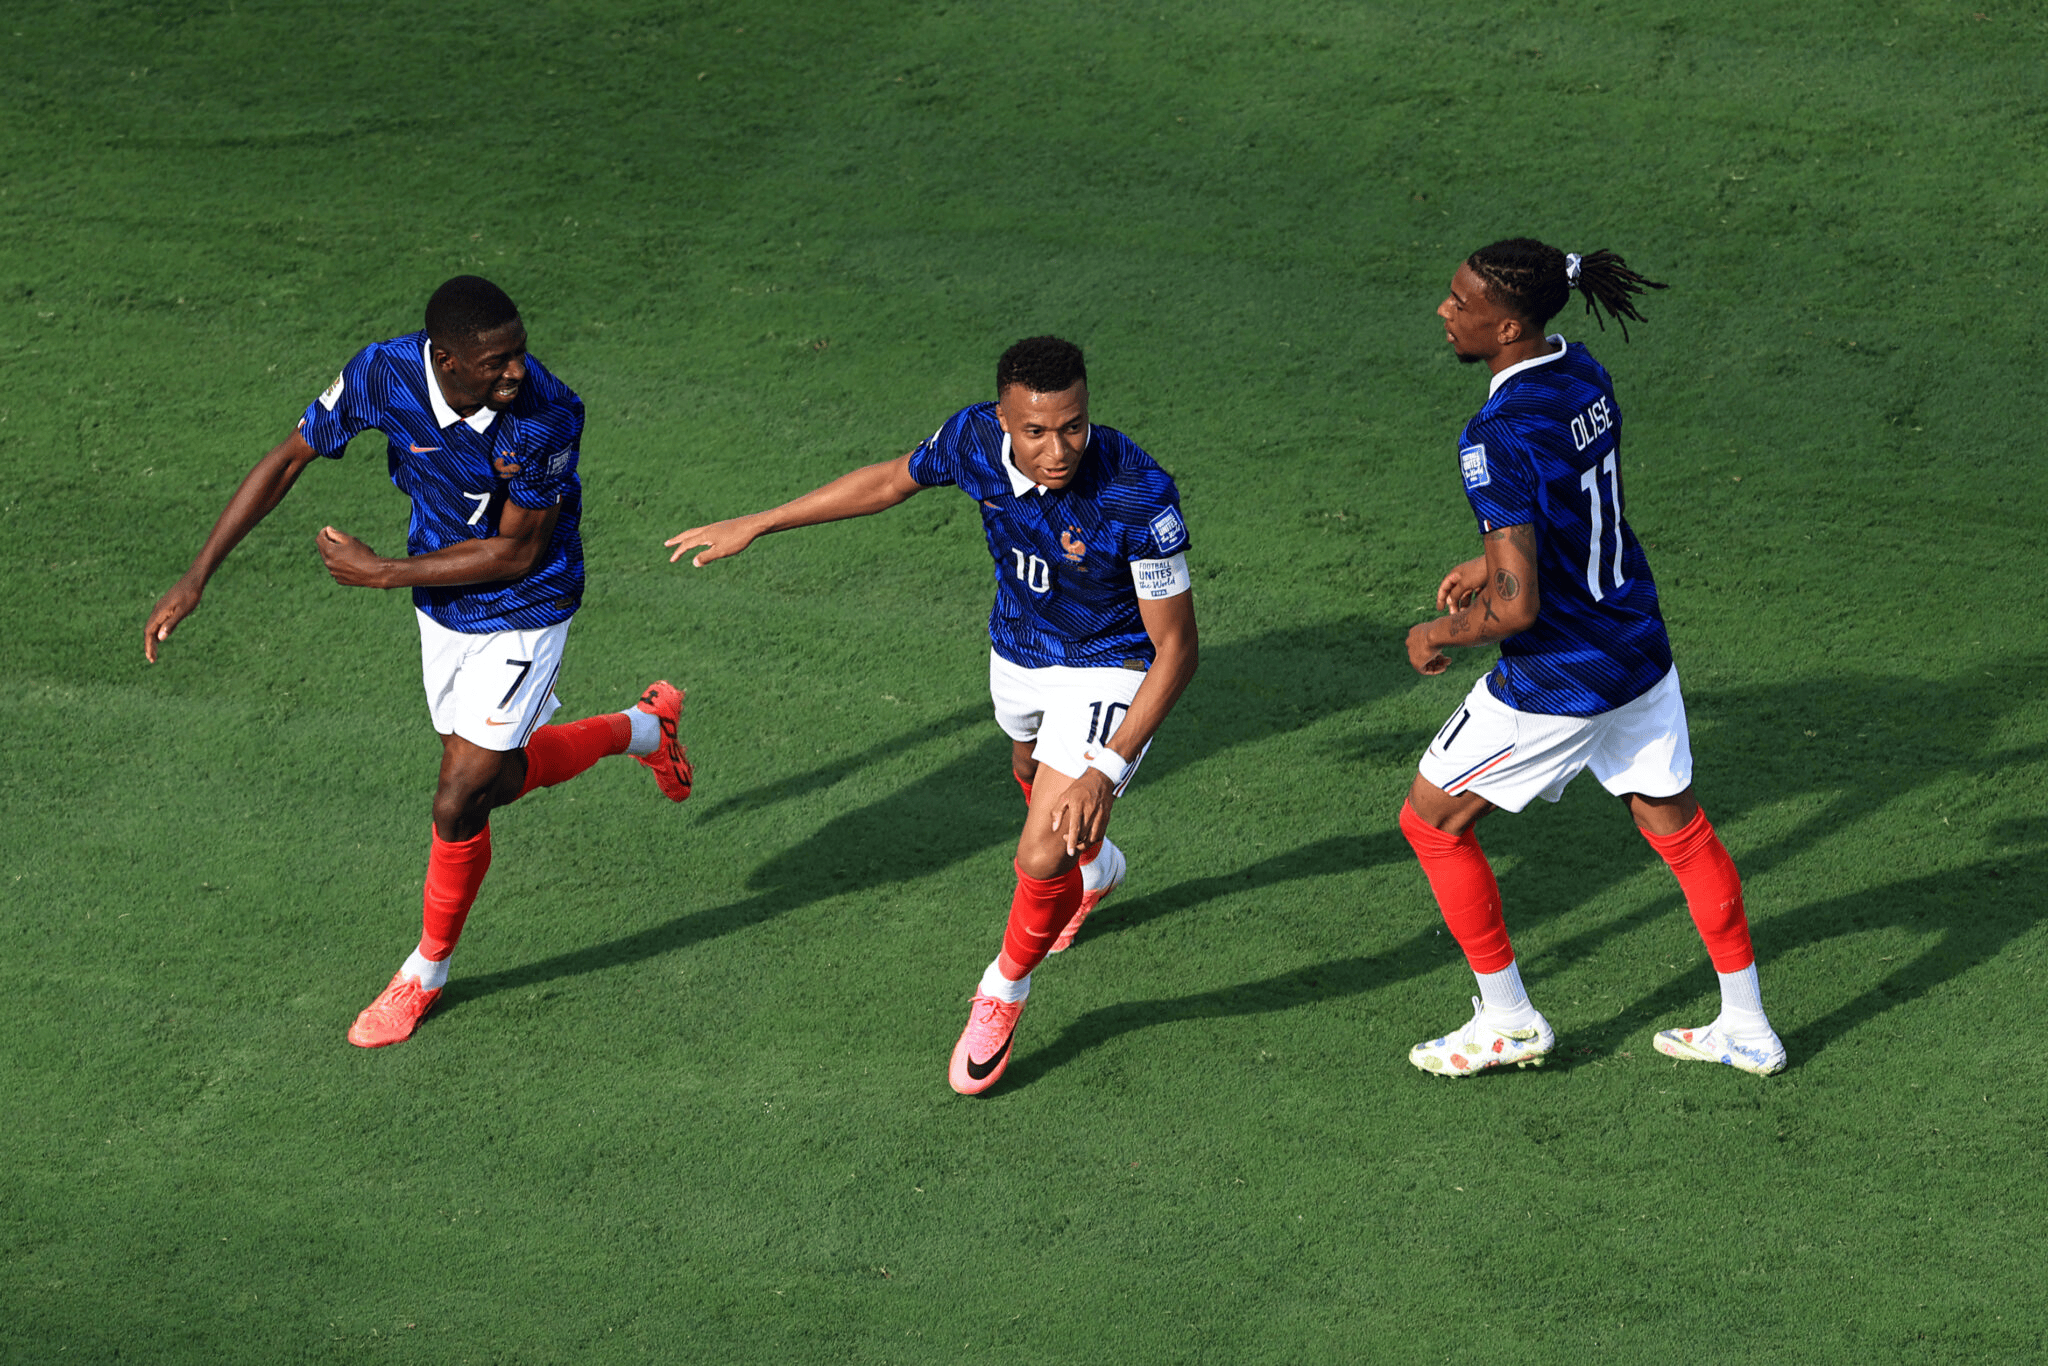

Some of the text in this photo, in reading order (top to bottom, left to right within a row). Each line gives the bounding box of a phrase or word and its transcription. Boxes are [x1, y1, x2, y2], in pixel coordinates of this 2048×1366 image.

[1570, 395, 1613, 452] OLISE
[463, 491, 491, 526] 7
[1580, 447, 1625, 603] 11
[1011, 547, 1050, 593] 10
[1139, 561, 1171, 570] FOOTBALL
[1139, 568, 1172, 581] UNITES
[1152, 576, 1176, 589] World
[497, 658, 533, 710] 7
[1086, 701, 1130, 748] 10
[1438, 701, 1471, 751] 11
